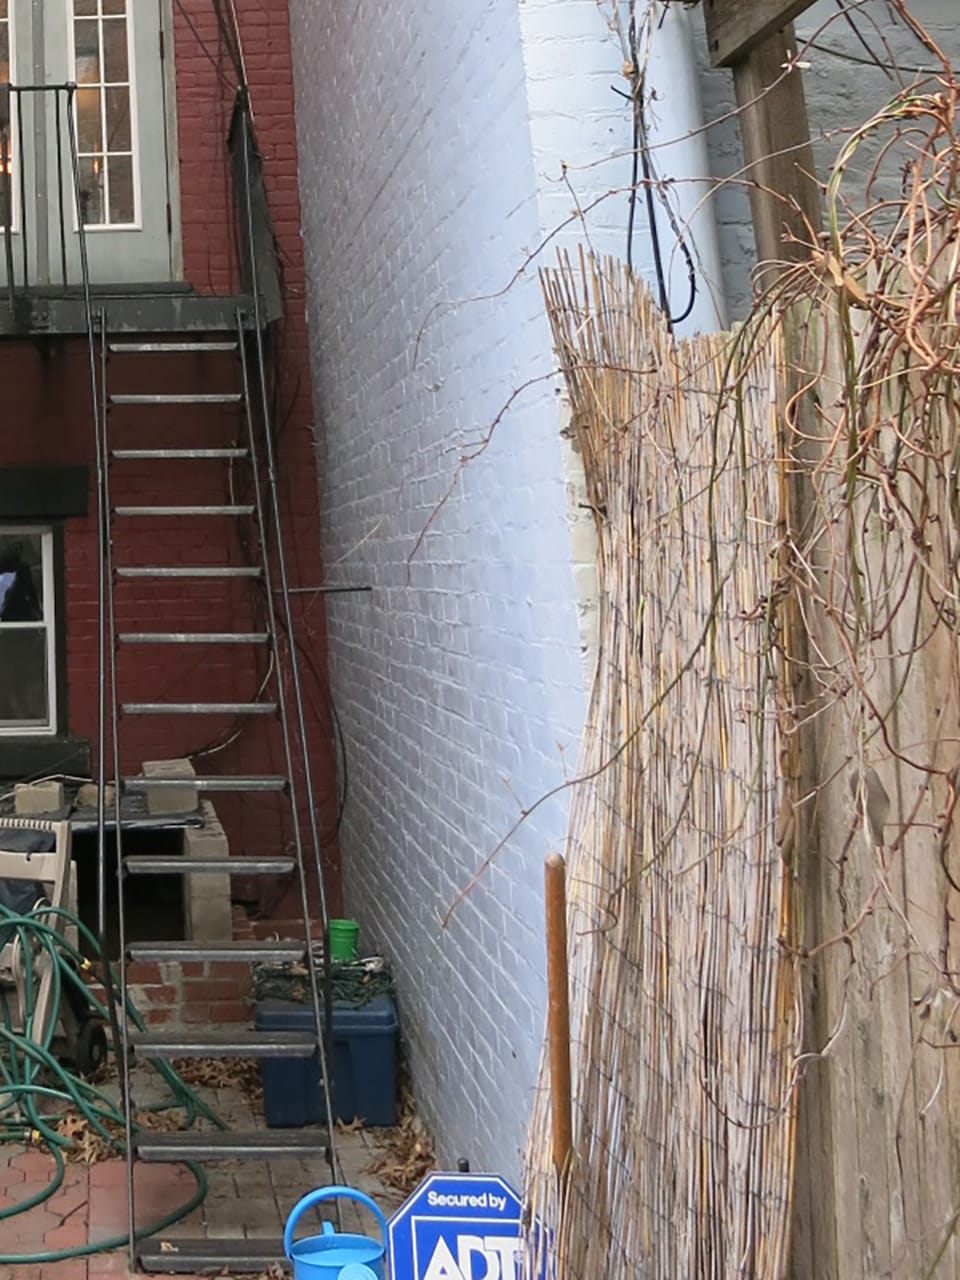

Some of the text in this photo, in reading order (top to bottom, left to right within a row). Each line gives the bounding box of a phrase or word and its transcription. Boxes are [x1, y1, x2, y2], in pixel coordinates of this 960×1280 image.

[427, 1191, 507, 1211] Secured by
[422, 1234, 524, 1280] ADT
